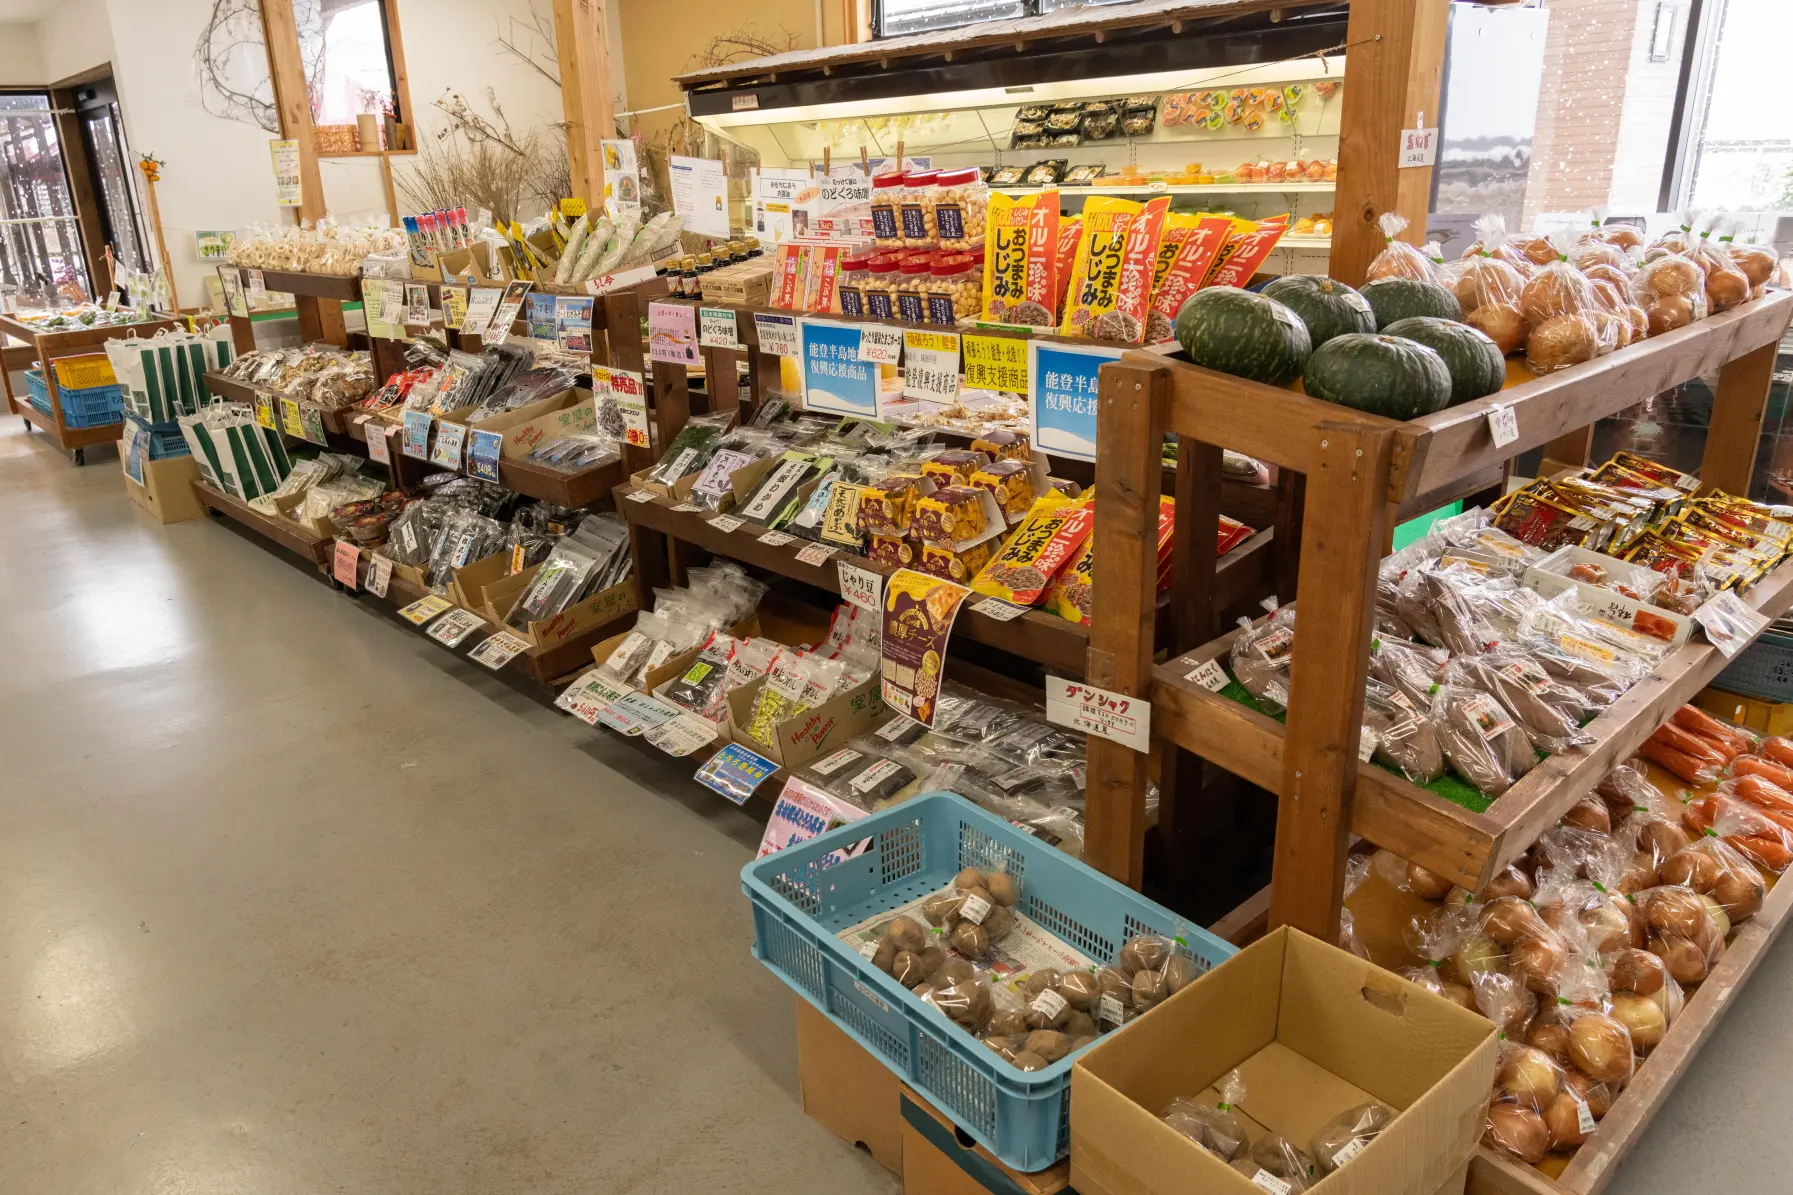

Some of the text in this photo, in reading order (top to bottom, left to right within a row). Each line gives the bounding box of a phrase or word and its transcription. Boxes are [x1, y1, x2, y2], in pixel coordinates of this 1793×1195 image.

[994, 227, 1011, 299] しじみ
[1009, 227, 1027, 300] おつまみ
[1027, 206, 1050, 302] オルニ珍味
[1081, 233, 1108, 307] しじみ
[808, 342, 864, 362] 能登半島地
[866, 347, 888, 360] ¥620
[810, 359, 867, 381] 復興応援商品
[965, 362, 1028, 390] 復興支援商品
[1001, 518, 1044, 562] しじみ
[1016, 518, 1064, 564] おつまみ
[843, 584, 876, 607] ¥460
[1065, 684, 1130, 715] ダンシャク
[790, 713, 821, 746] Healthy
[811, 717, 835, 746] Power
